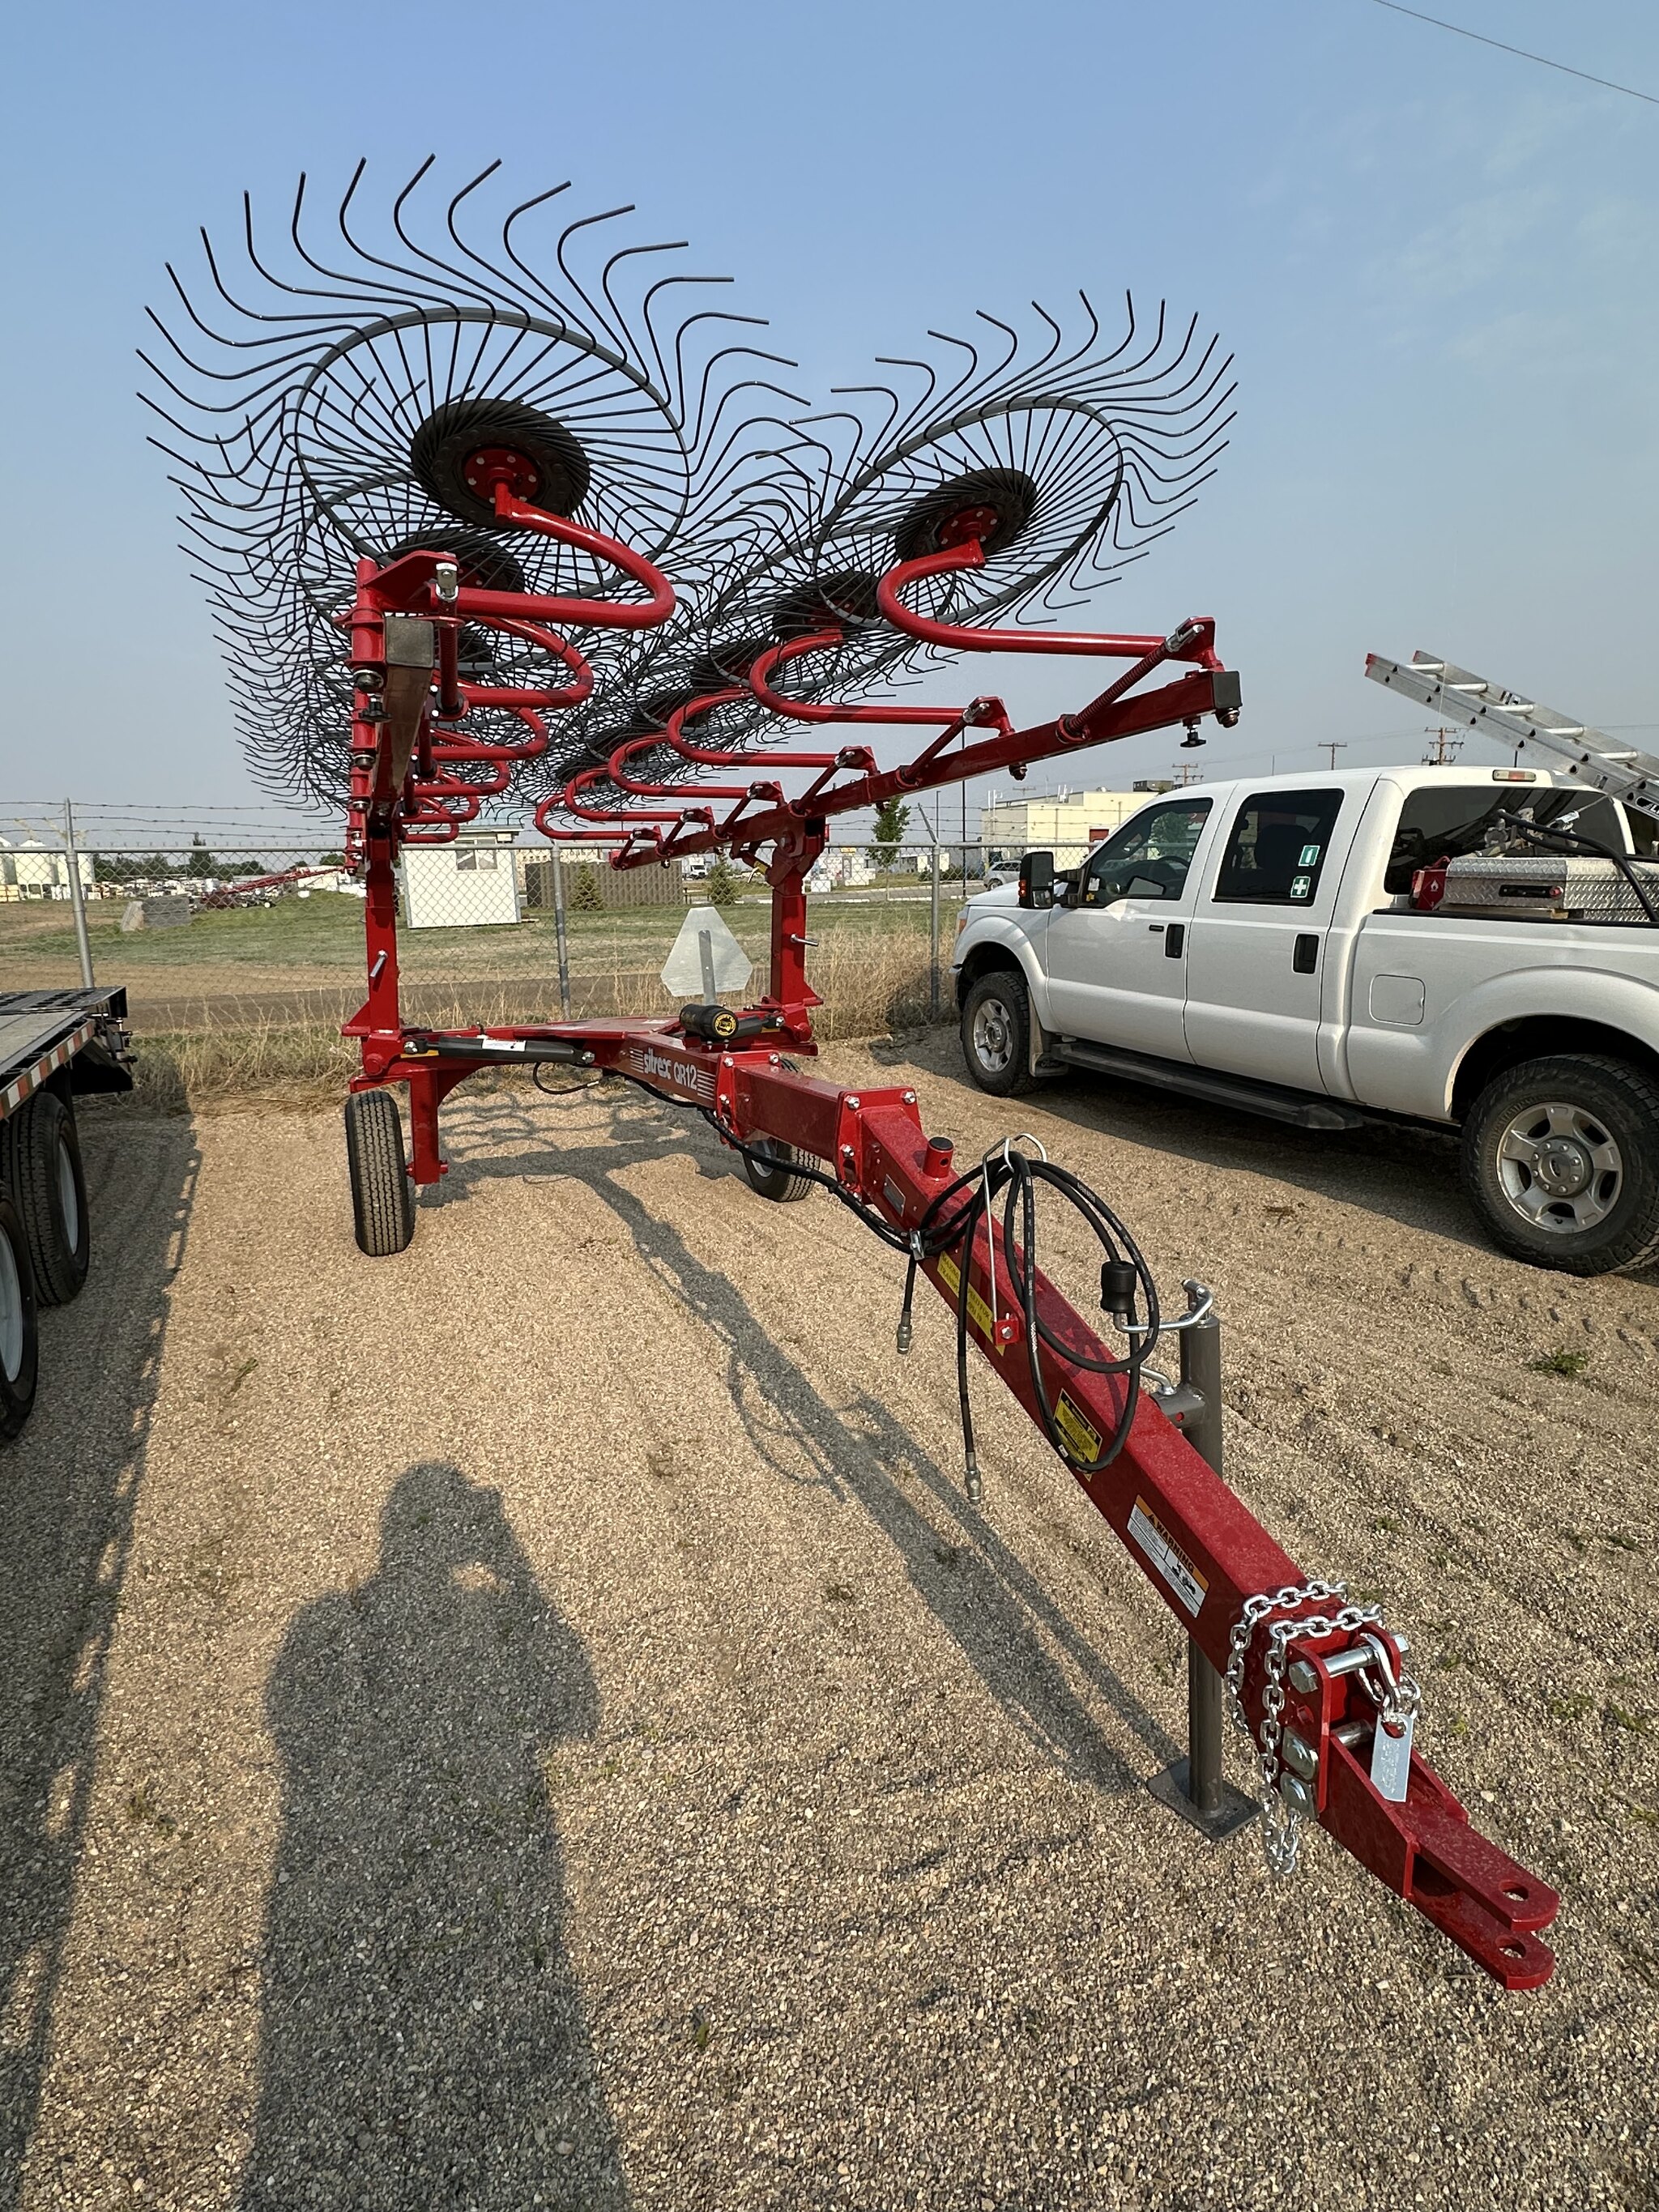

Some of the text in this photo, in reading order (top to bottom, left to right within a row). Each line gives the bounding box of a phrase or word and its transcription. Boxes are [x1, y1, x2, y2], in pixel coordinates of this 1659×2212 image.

[644, 1047, 697, 1090] sitrex QR12
[1157, 1521, 1195, 1575] WARNING
